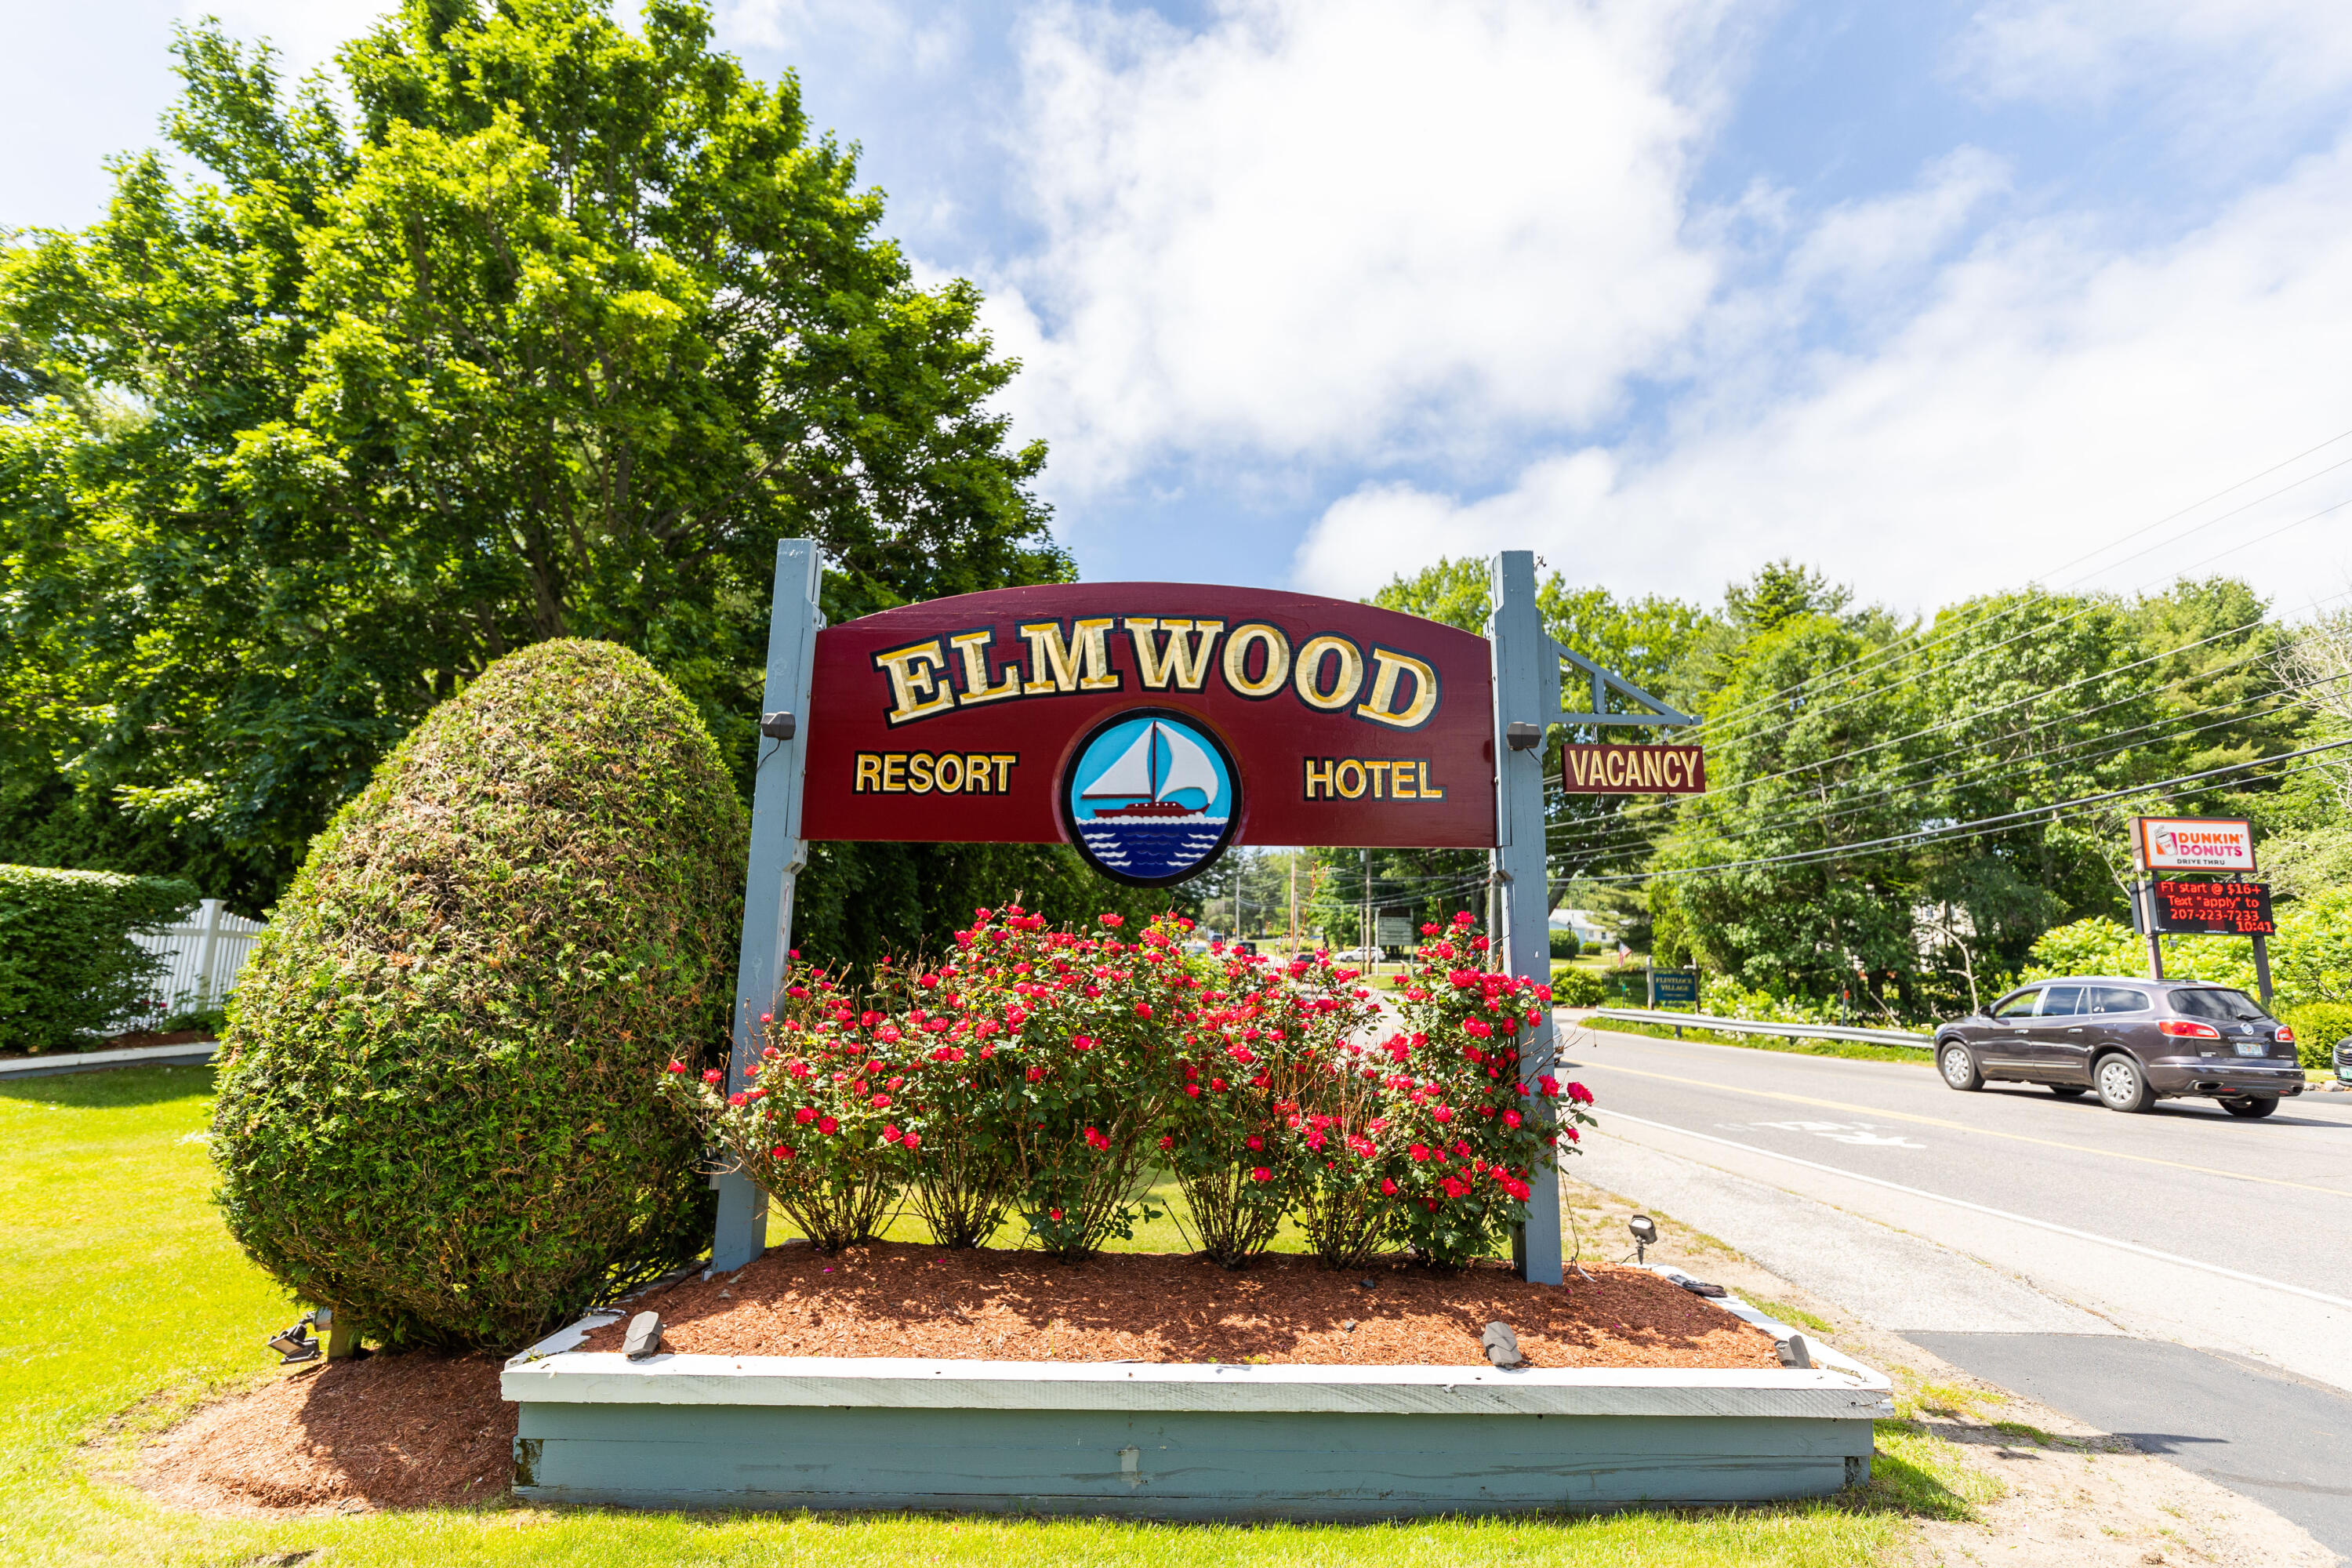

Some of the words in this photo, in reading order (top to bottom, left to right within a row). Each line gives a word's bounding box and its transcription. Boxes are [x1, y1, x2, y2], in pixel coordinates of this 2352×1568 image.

[876, 617, 1439, 728] ELMWOOD
[1570, 750, 1699, 787] VACANCY
[855, 753, 1017, 793] RESORT
[1305, 759, 1443, 800] HOTEL
[2178, 833, 2244, 844] DUNKIN'
[2180, 845, 2243, 857] DONUTS
[2161, 882, 2176, 892] FT
[2179, 883, 2208, 894] start
[2211, 884, 2223, 895] @
[2227, 883, 2261, 895] $16+
[2167, 895, 2194, 906] Text
[2196, 896, 2241, 909] "apply"
[2245, 897, 2259, 907] to
[2170, 909, 2259, 921] 207-223-7233
[2236, 920, 2274, 933] 10:41
